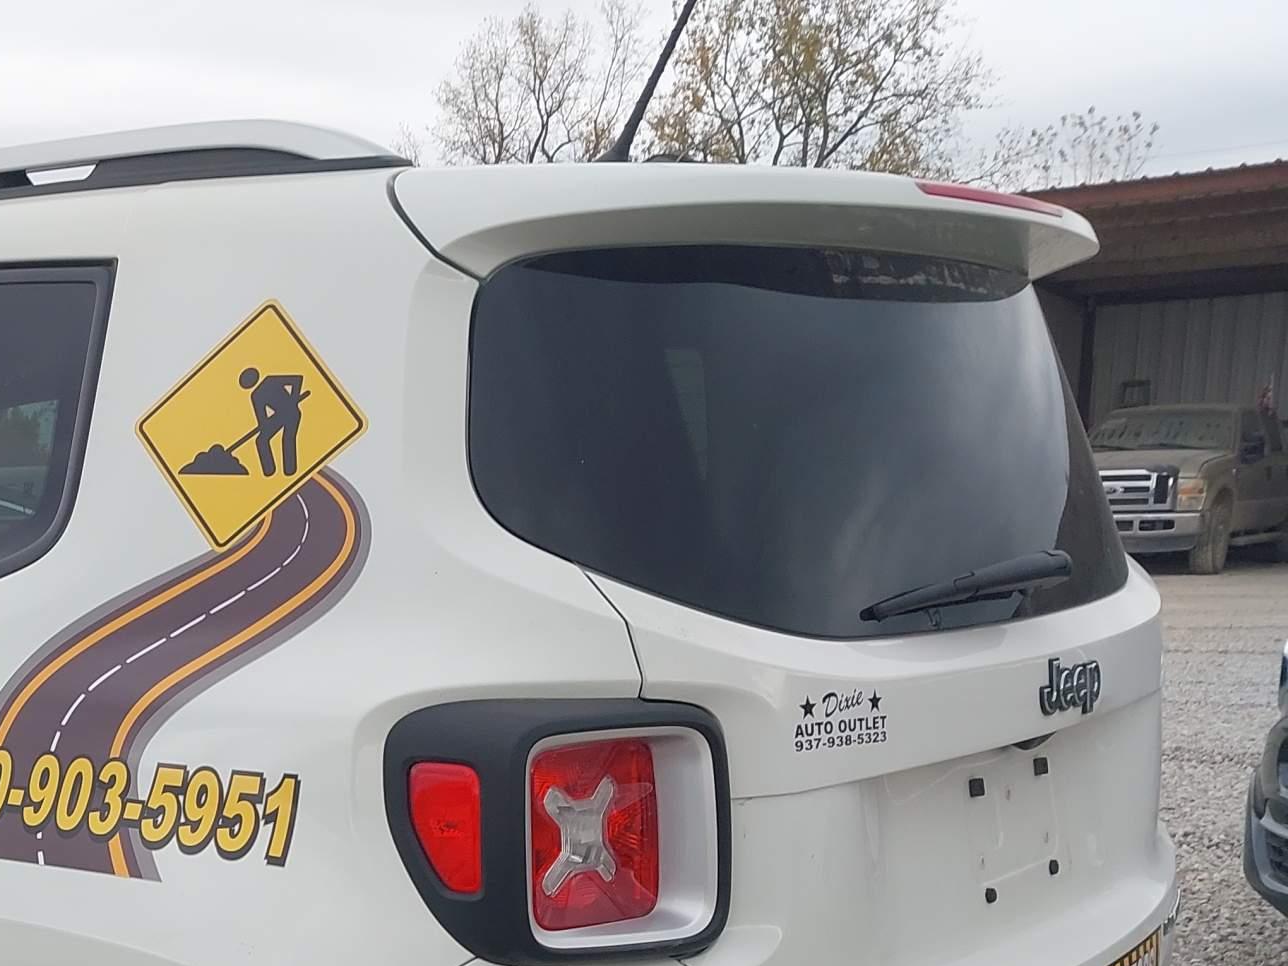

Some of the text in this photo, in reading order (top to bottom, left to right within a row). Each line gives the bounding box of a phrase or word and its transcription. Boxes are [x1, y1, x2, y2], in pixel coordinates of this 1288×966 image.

[1039, 657, 1101, 716] Jeep
[822, 688, 864, 718] Dixie
[795, 715, 887, 739] AUTO OUTLET
[795, 731, 887, 752] 937-938-5323
